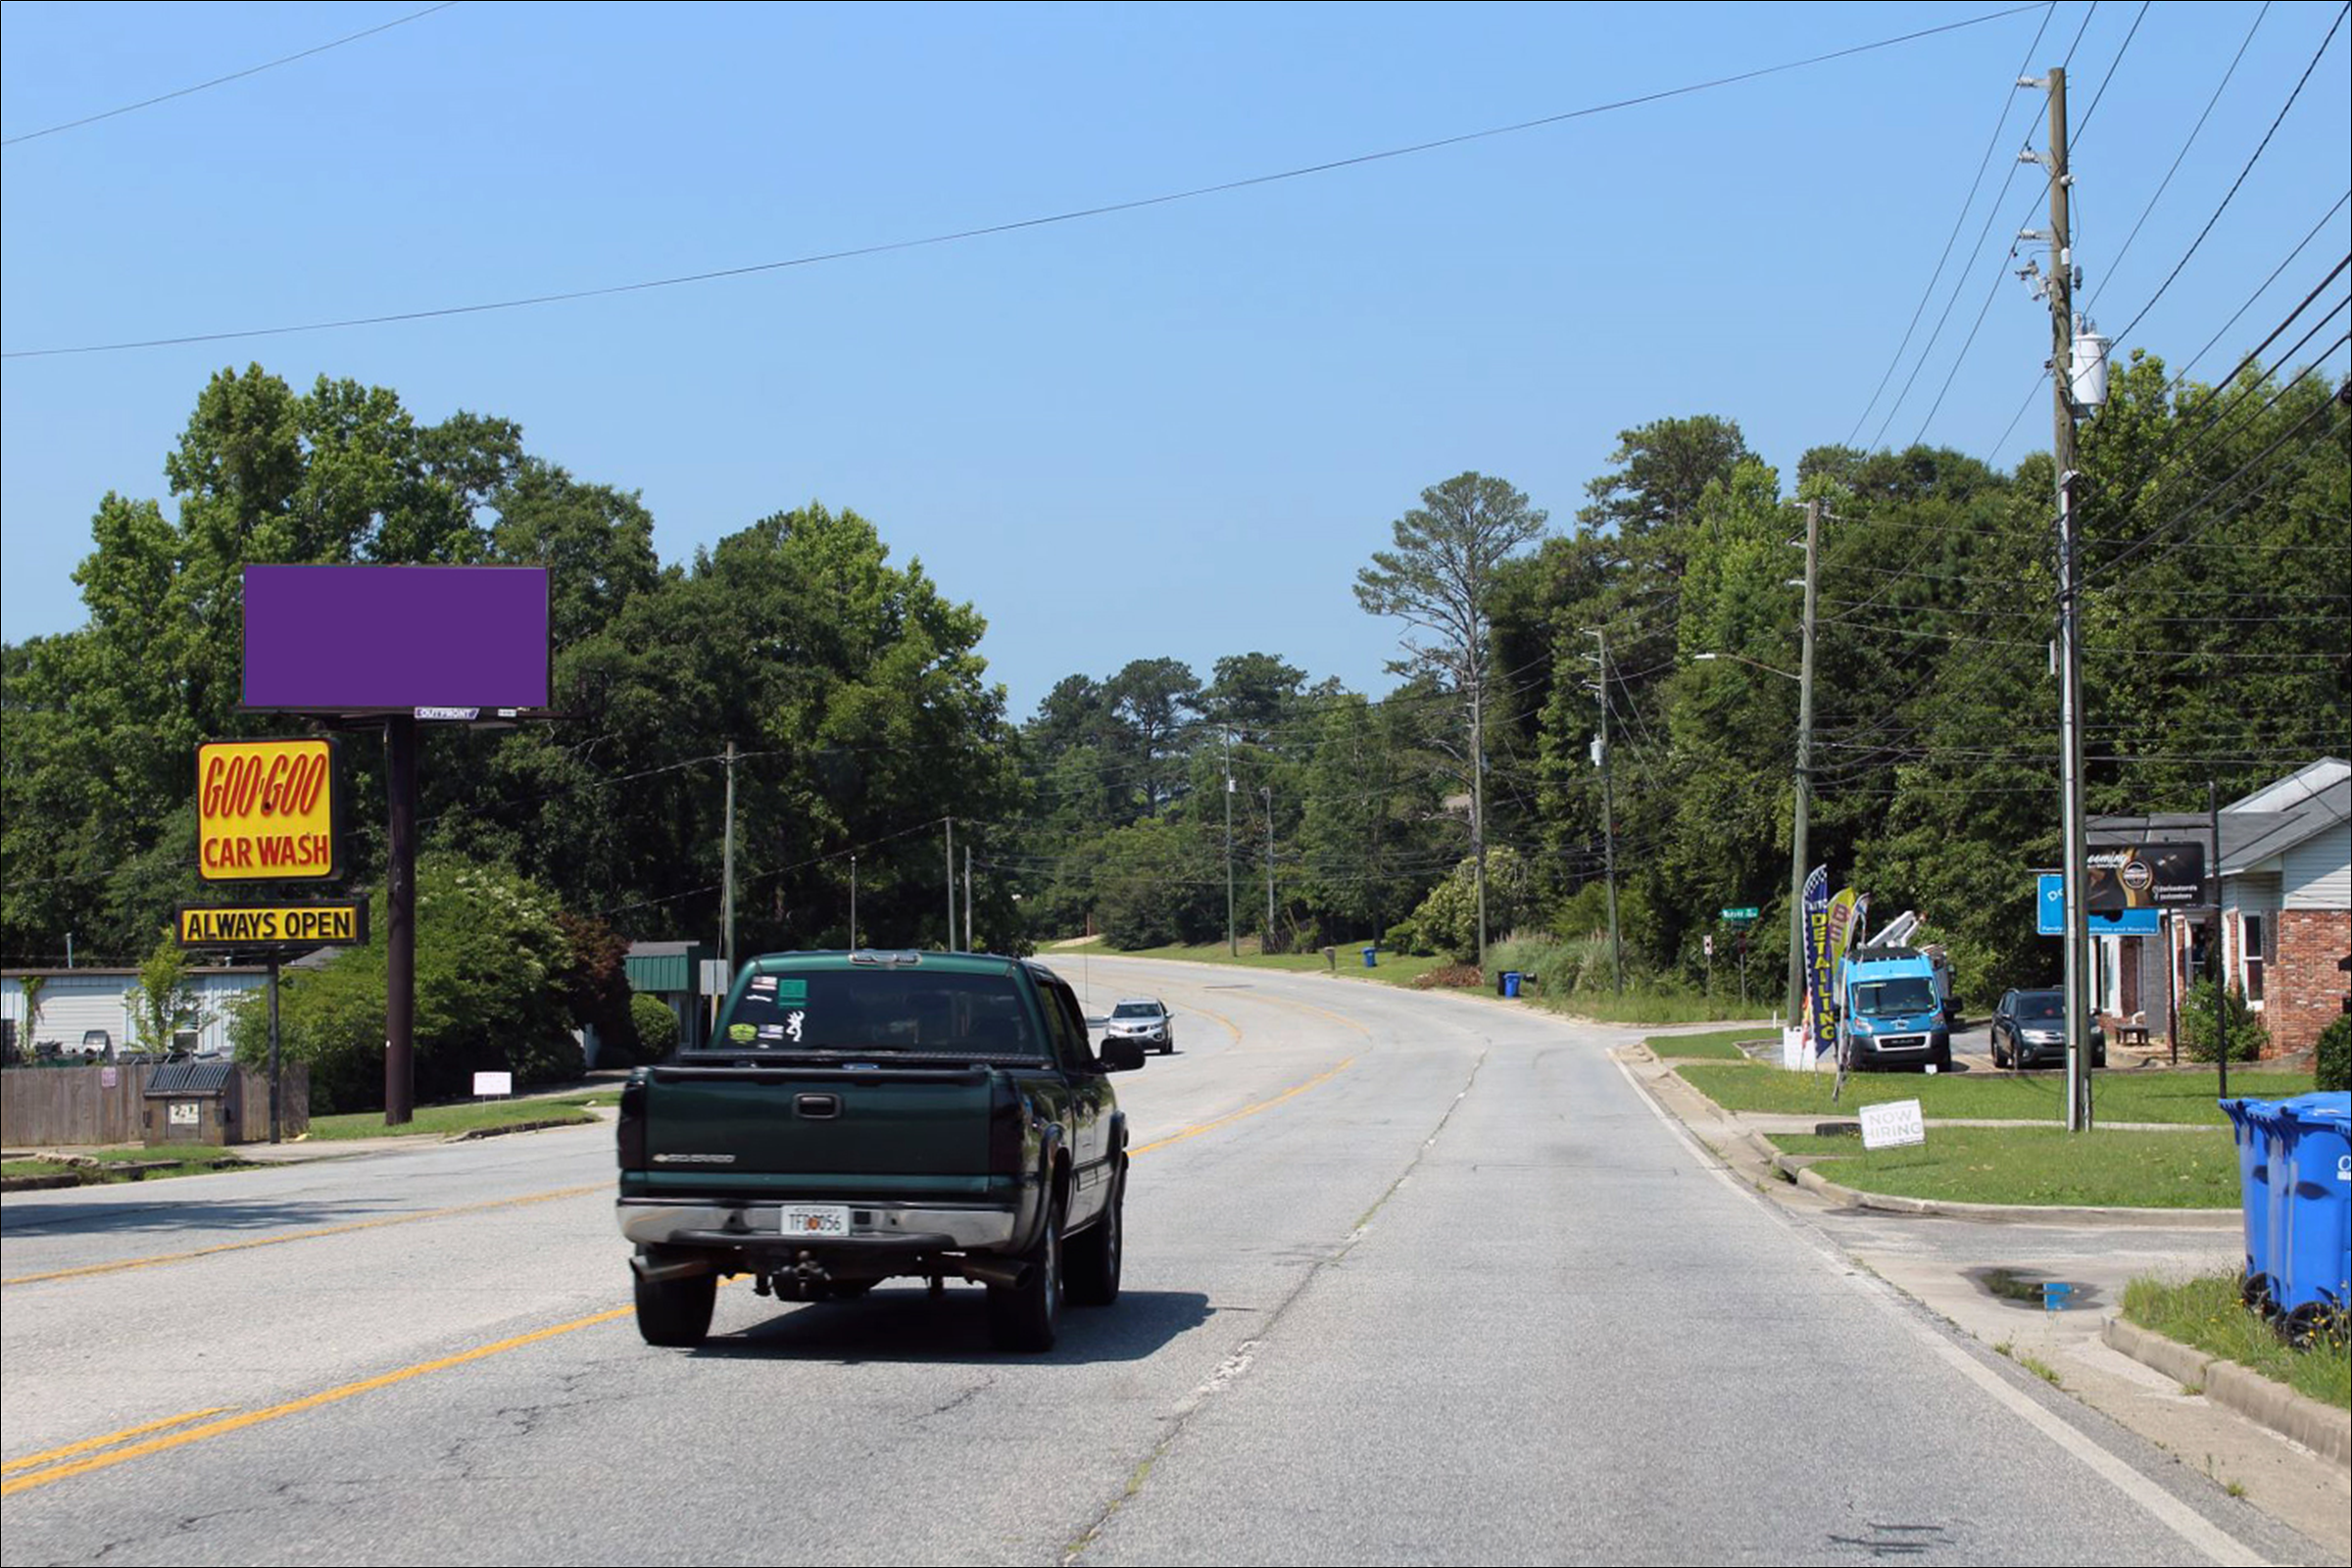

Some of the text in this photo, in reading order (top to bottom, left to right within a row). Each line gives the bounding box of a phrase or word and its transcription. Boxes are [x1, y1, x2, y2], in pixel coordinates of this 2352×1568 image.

[204, 834, 328, 868] CAR WASH
[187, 911, 350, 939] ALWAYS OPEN
[1811, 912, 1836, 1041] DETAILING
[1865, 1122, 1922, 1139] HIRING
[1869, 1109, 1912, 1125] NOW
